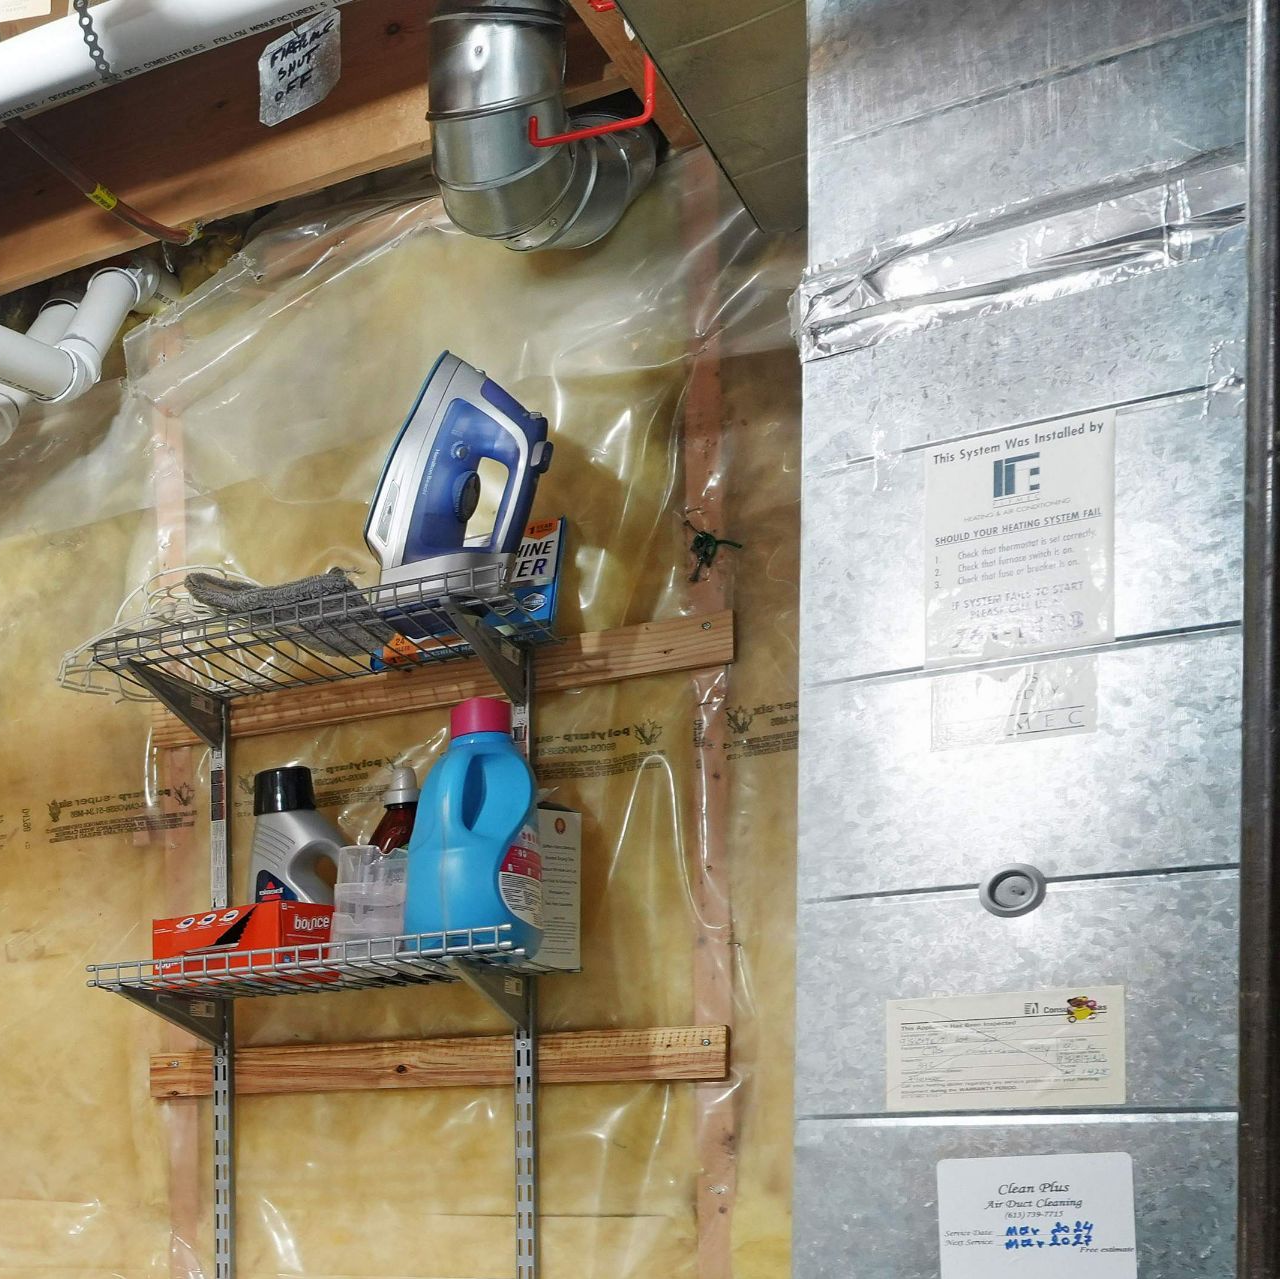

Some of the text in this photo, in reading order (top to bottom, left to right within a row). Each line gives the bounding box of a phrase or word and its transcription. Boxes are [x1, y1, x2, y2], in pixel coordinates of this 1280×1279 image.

[143, 45, 206, 67] COMBUSTIBLES
[212, 30, 248, 44] FOLLOW
[933, 421, 1105, 465] This System Was Installed by
[935, 507, 1102, 546] SHOULD YOUR HEATING SYSTEM FAIL
[957, 550, 979, 560] Check
[981, 546, 997, 557] that
[1040, 536, 1048, 545] is
[957, 562, 979, 573] Check
[981, 559, 997, 569] that
[1028, 548, 1052, 560] switch
[957, 574, 979, 586] Check
[981, 571, 996, 582] that
[998, 567, 1014, 579] fuse
[1016, 568, 1025, 576] or
[1026, 562, 1057, 575] breaker
[293, 913, 330, 932] bounce
[998, 1180, 1070, 1196] Clean Plus
[984, 1198, 1083, 1211] Air Duct Cleaning
[1079, 1245, 1099, 1254] Free
